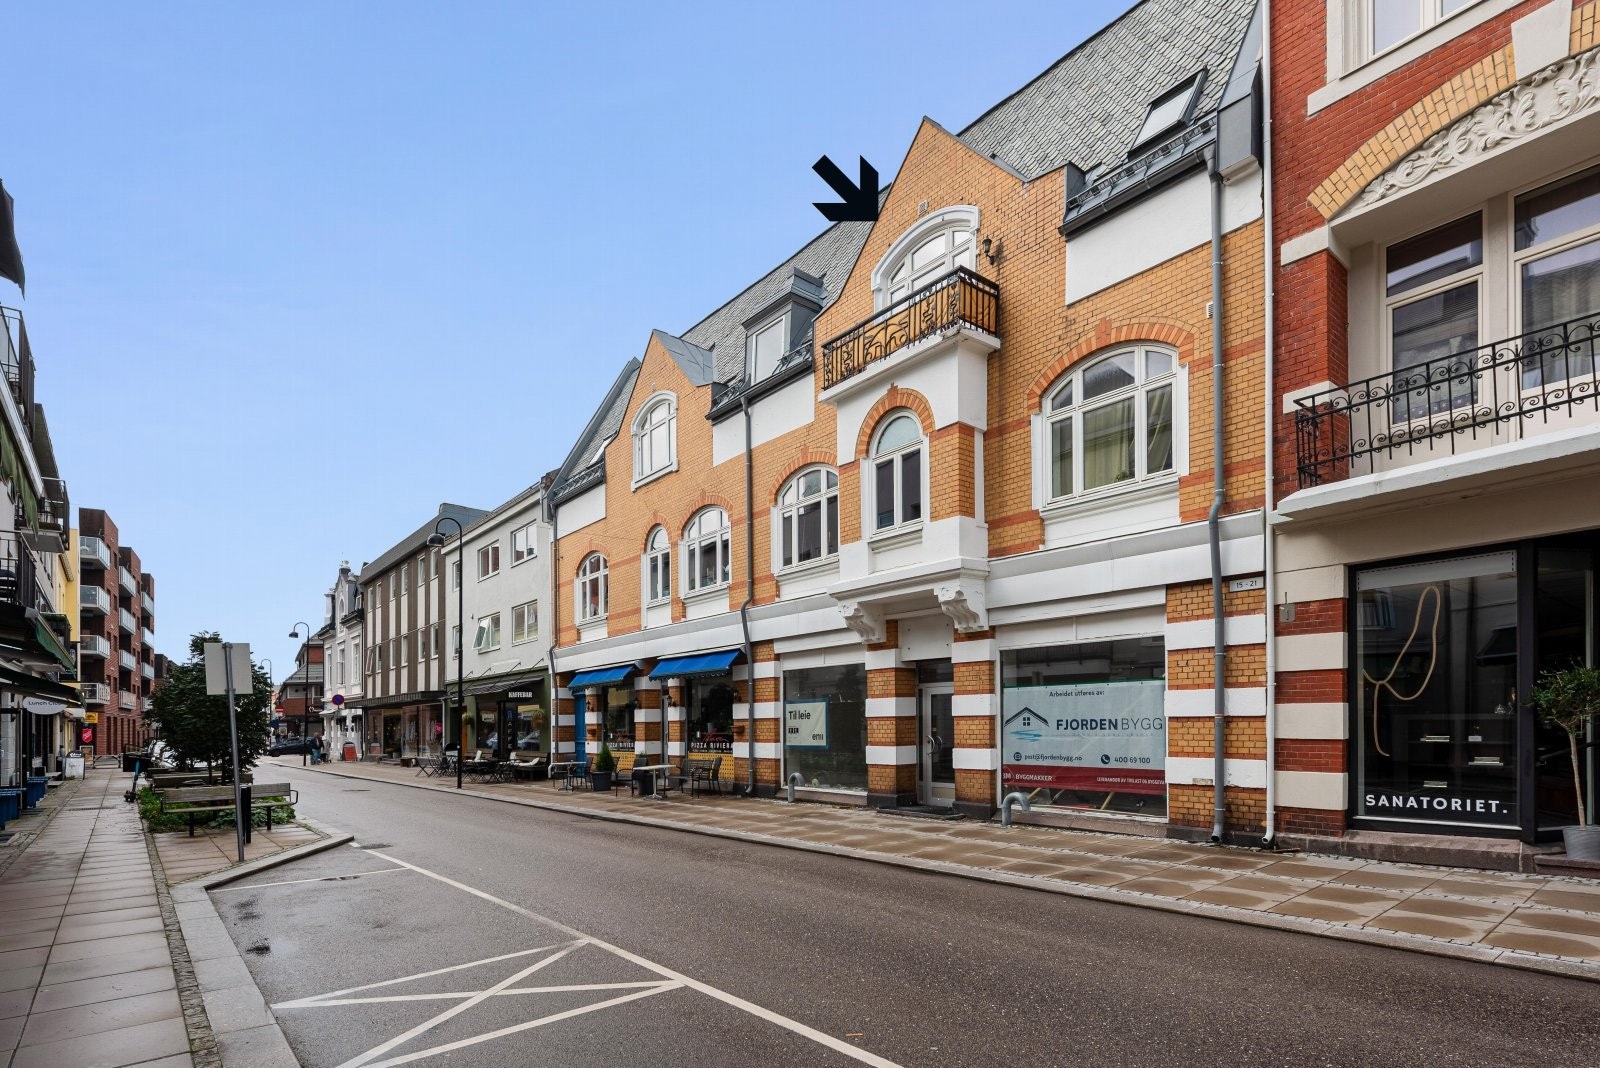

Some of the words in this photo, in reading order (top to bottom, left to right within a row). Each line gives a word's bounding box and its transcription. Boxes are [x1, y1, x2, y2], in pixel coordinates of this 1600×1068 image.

[788, 710, 797, 720] Til
[798, 710, 811, 720] leie
[1024, 753, 1083, 763] post@fjordenbygg.no
[1129, 756, 1138, 764] 69
[1365, 794, 1508, 814] SANATORIET.
